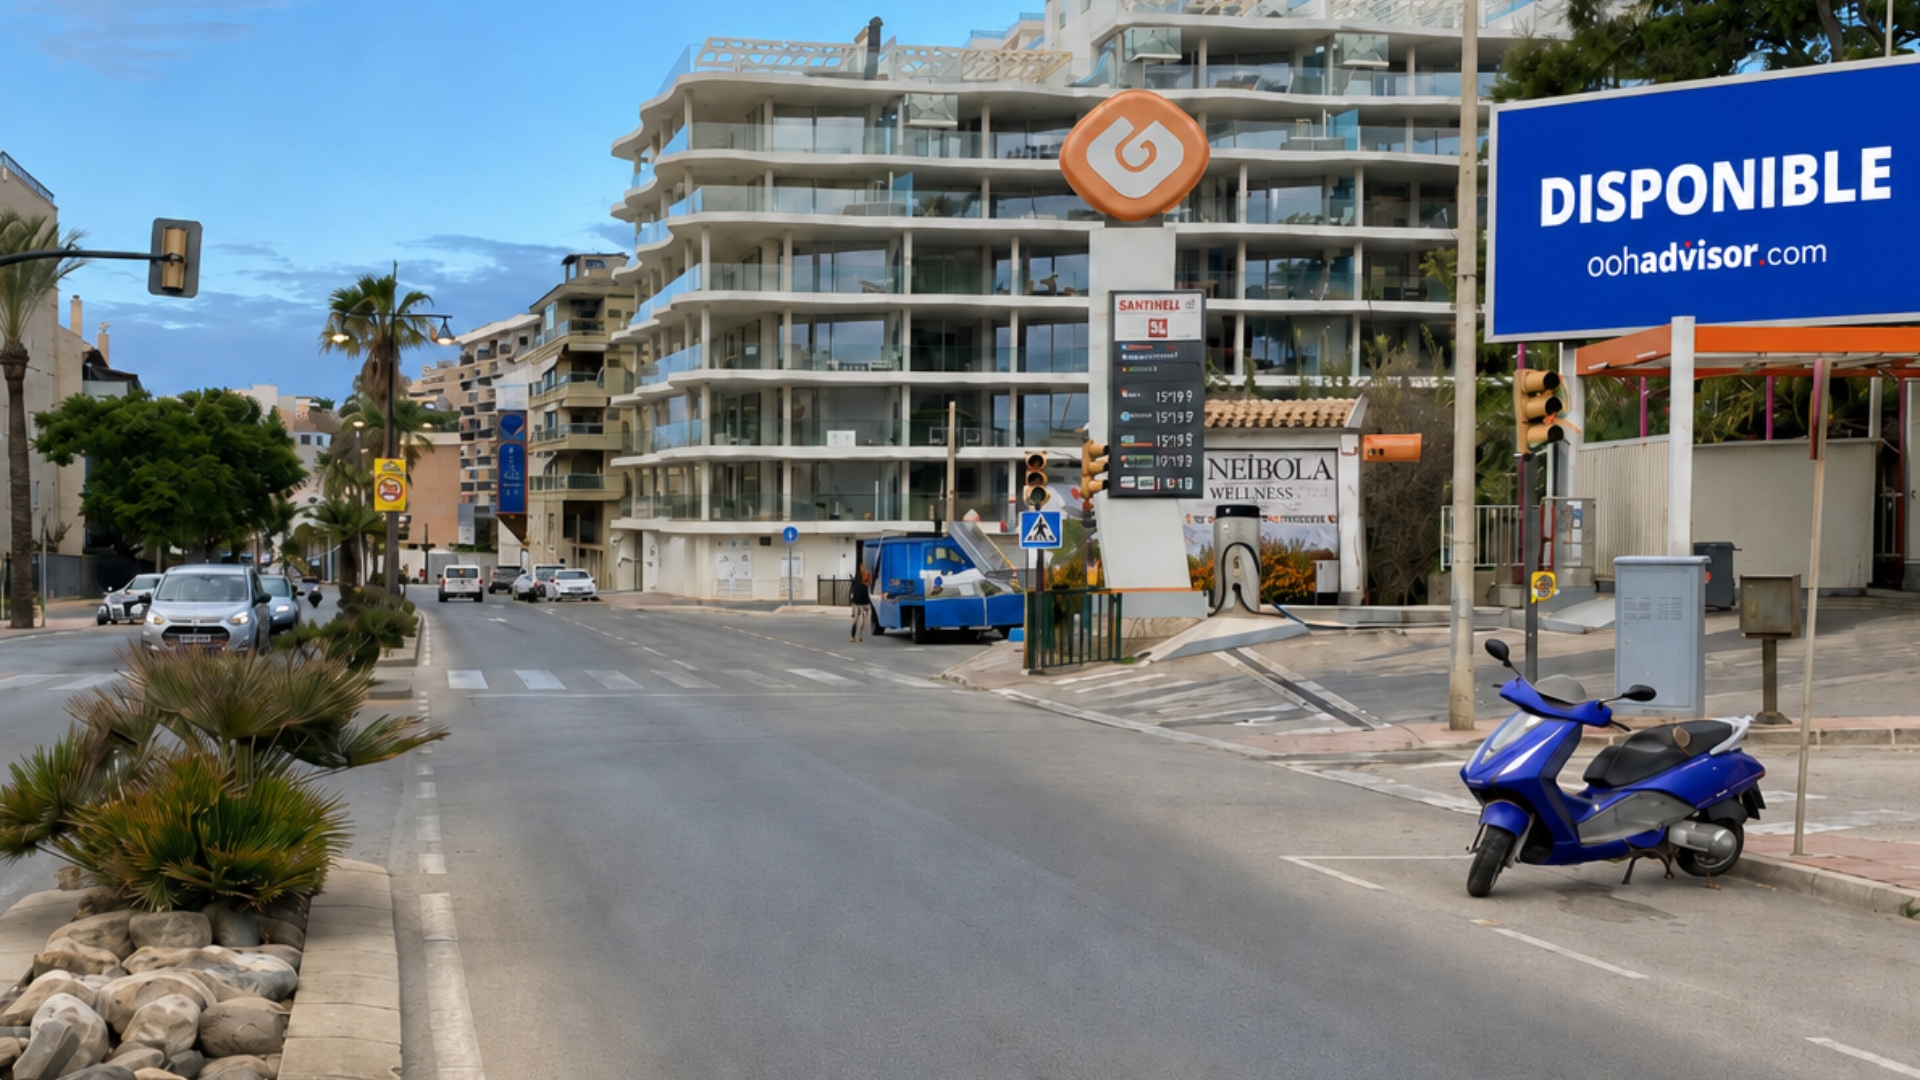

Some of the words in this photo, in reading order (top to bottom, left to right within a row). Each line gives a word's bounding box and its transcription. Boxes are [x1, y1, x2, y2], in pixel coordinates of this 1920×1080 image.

[1541, 146, 1892, 227] DISPONIBLE
[1587, 239, 1827, 277] oohadvisor.com
[1210, 487, 1293, 500] WELLNESS
